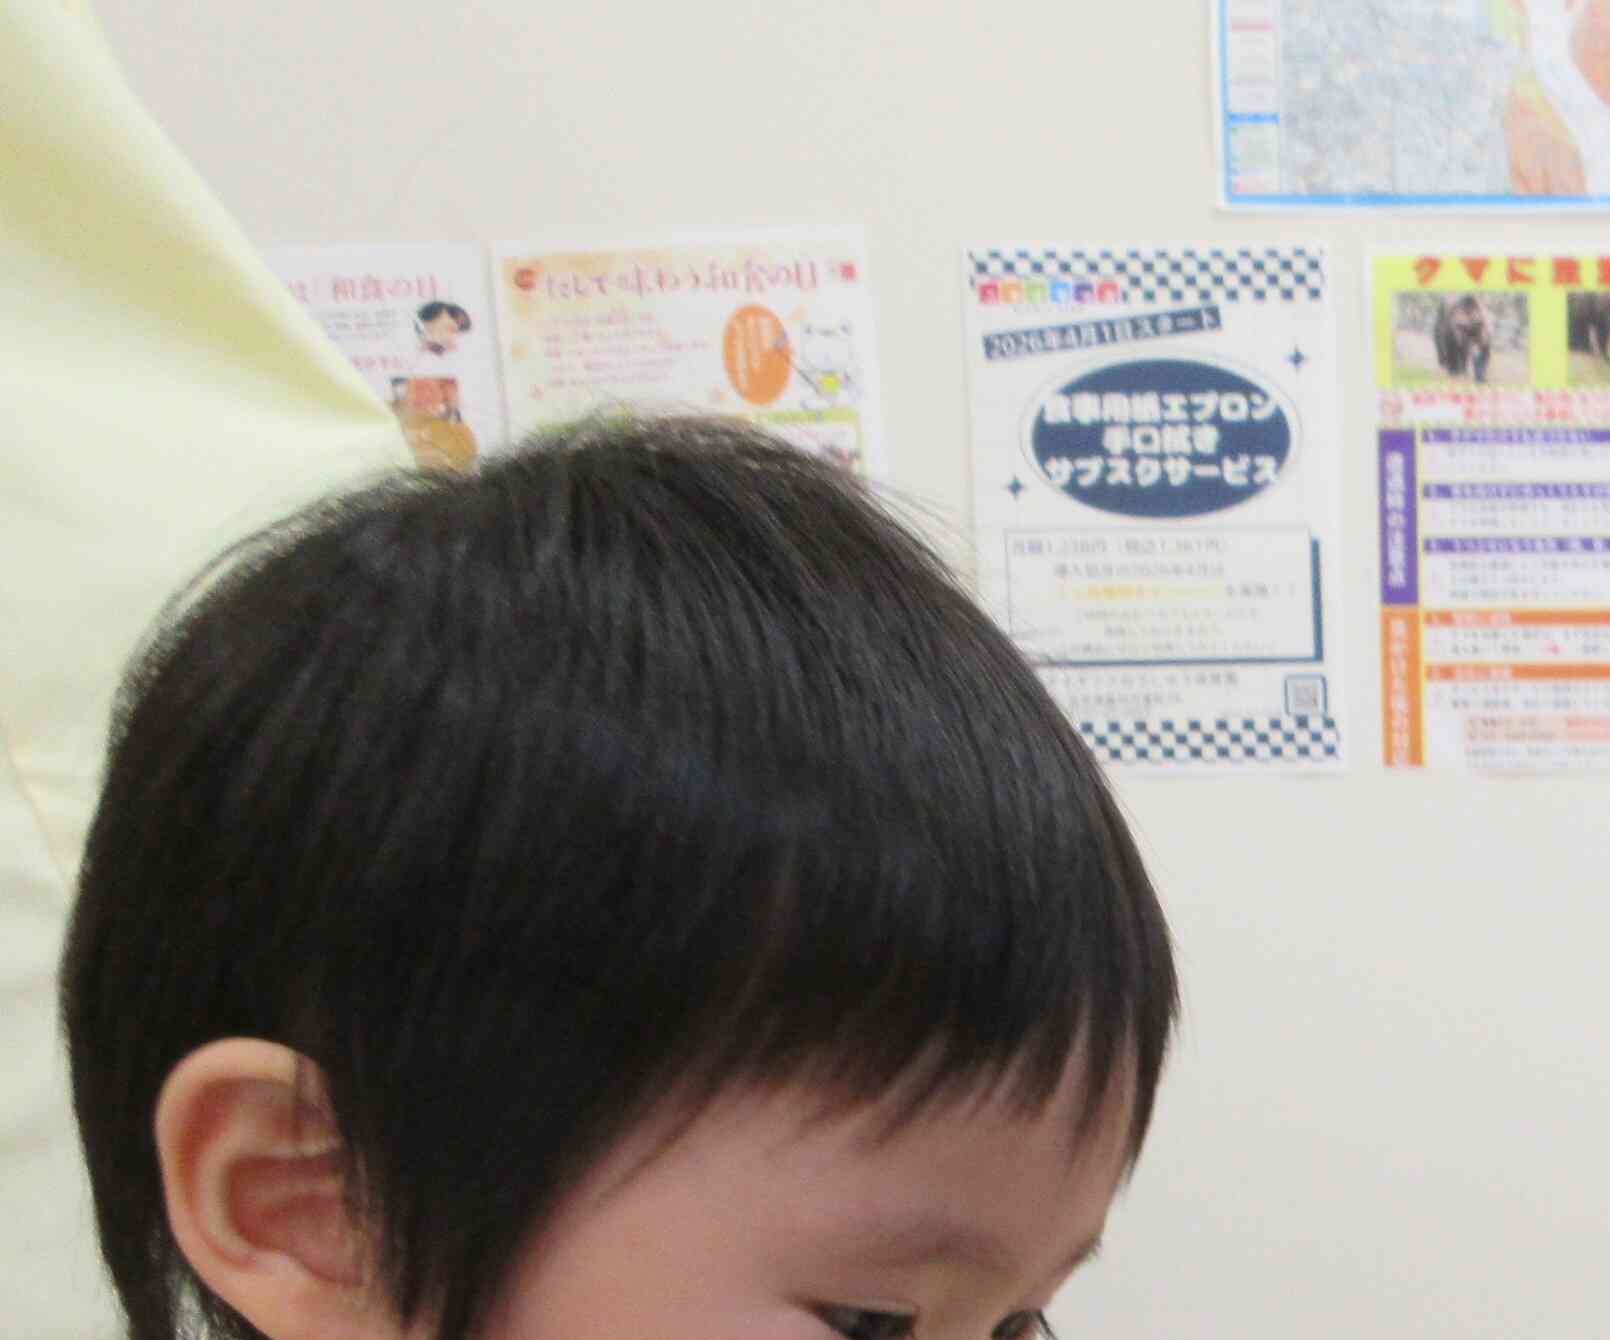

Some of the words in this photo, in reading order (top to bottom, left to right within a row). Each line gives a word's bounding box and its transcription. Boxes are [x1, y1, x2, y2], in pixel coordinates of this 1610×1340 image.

[1044, 454, 1279, 486] サブスクサービス
